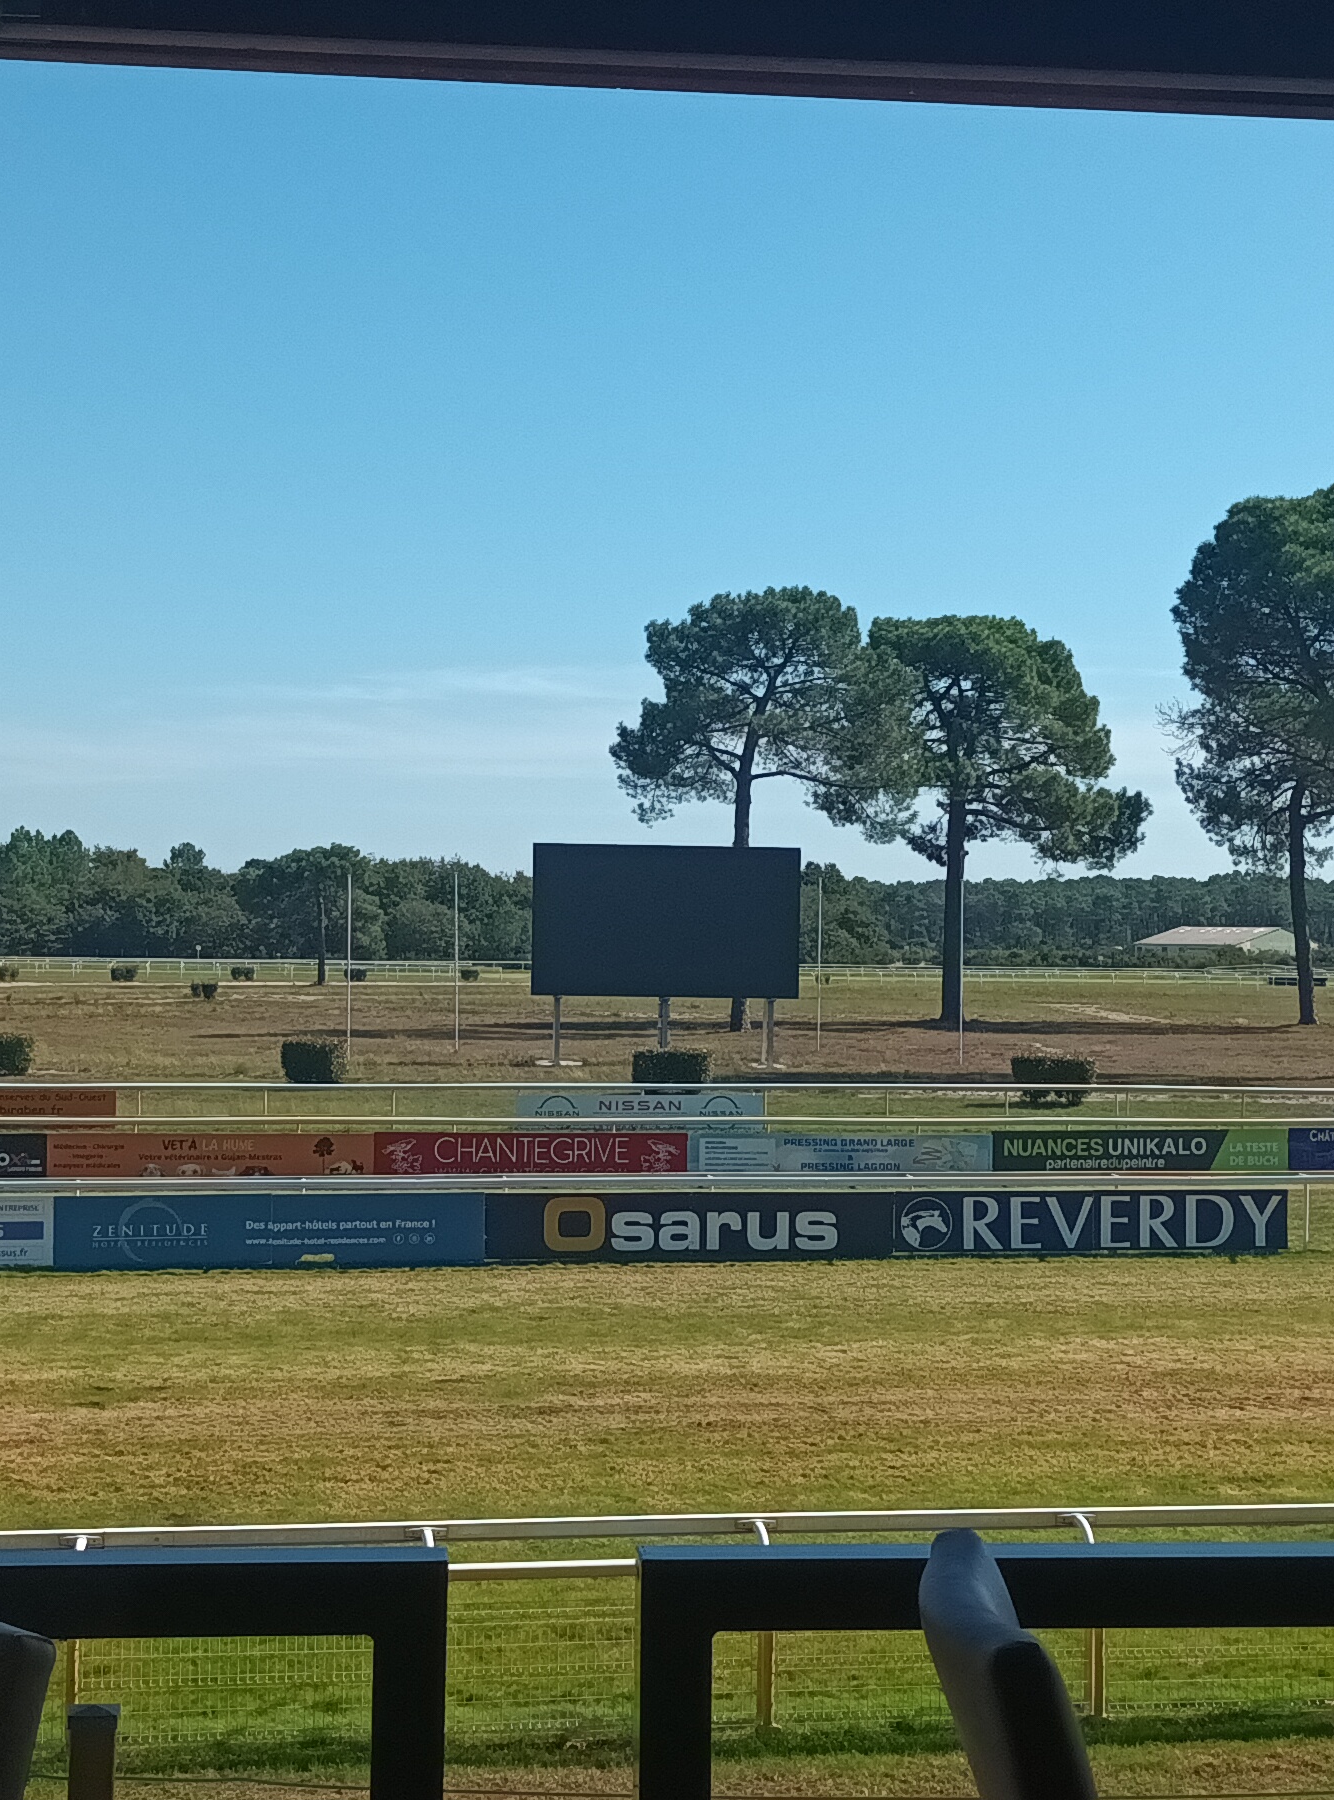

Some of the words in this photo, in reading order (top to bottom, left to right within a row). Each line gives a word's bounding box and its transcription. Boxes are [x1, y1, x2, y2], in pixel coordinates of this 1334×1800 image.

[599, 1101, 681, 1111] NISSAN
[202, 1140, 219, 1151] LA
[783, 1138, 838, 1147] PRESSING
[841, 1138, 878, 1147] GRAND
[881, 1139, 915, 1147] LARGE
[1003, 1138, 1104, 1156] NUANCES
[1108, 1138, 1207, 1155] UNIKALO
[1229, 1142, 1247, 1152] LA
[1250, 1142, 1279, 1152] TESTE
[434, 1137, 629, 1164] CHANTEGRIVE
[1229, 1156, 1245, 1166] DE
[1247, 1155, 1279, 1166] BUCH
[800, 1162, 854, 1171] PRESSING
[858, 1162, 901, 1171] LAGOON
[246, 1221, 265, 1229] Des
[268, 1220, 337, 1231] appart-hôtels
[340, 1220, 377, 1230] partout
[395, 1220, 430, 1229] France
[543, 1196, 838, 1252] Osarus
[962, 1193, 1285, 1251] REVERDY
[93, 1223, 208, 1237] ZENITUDE
